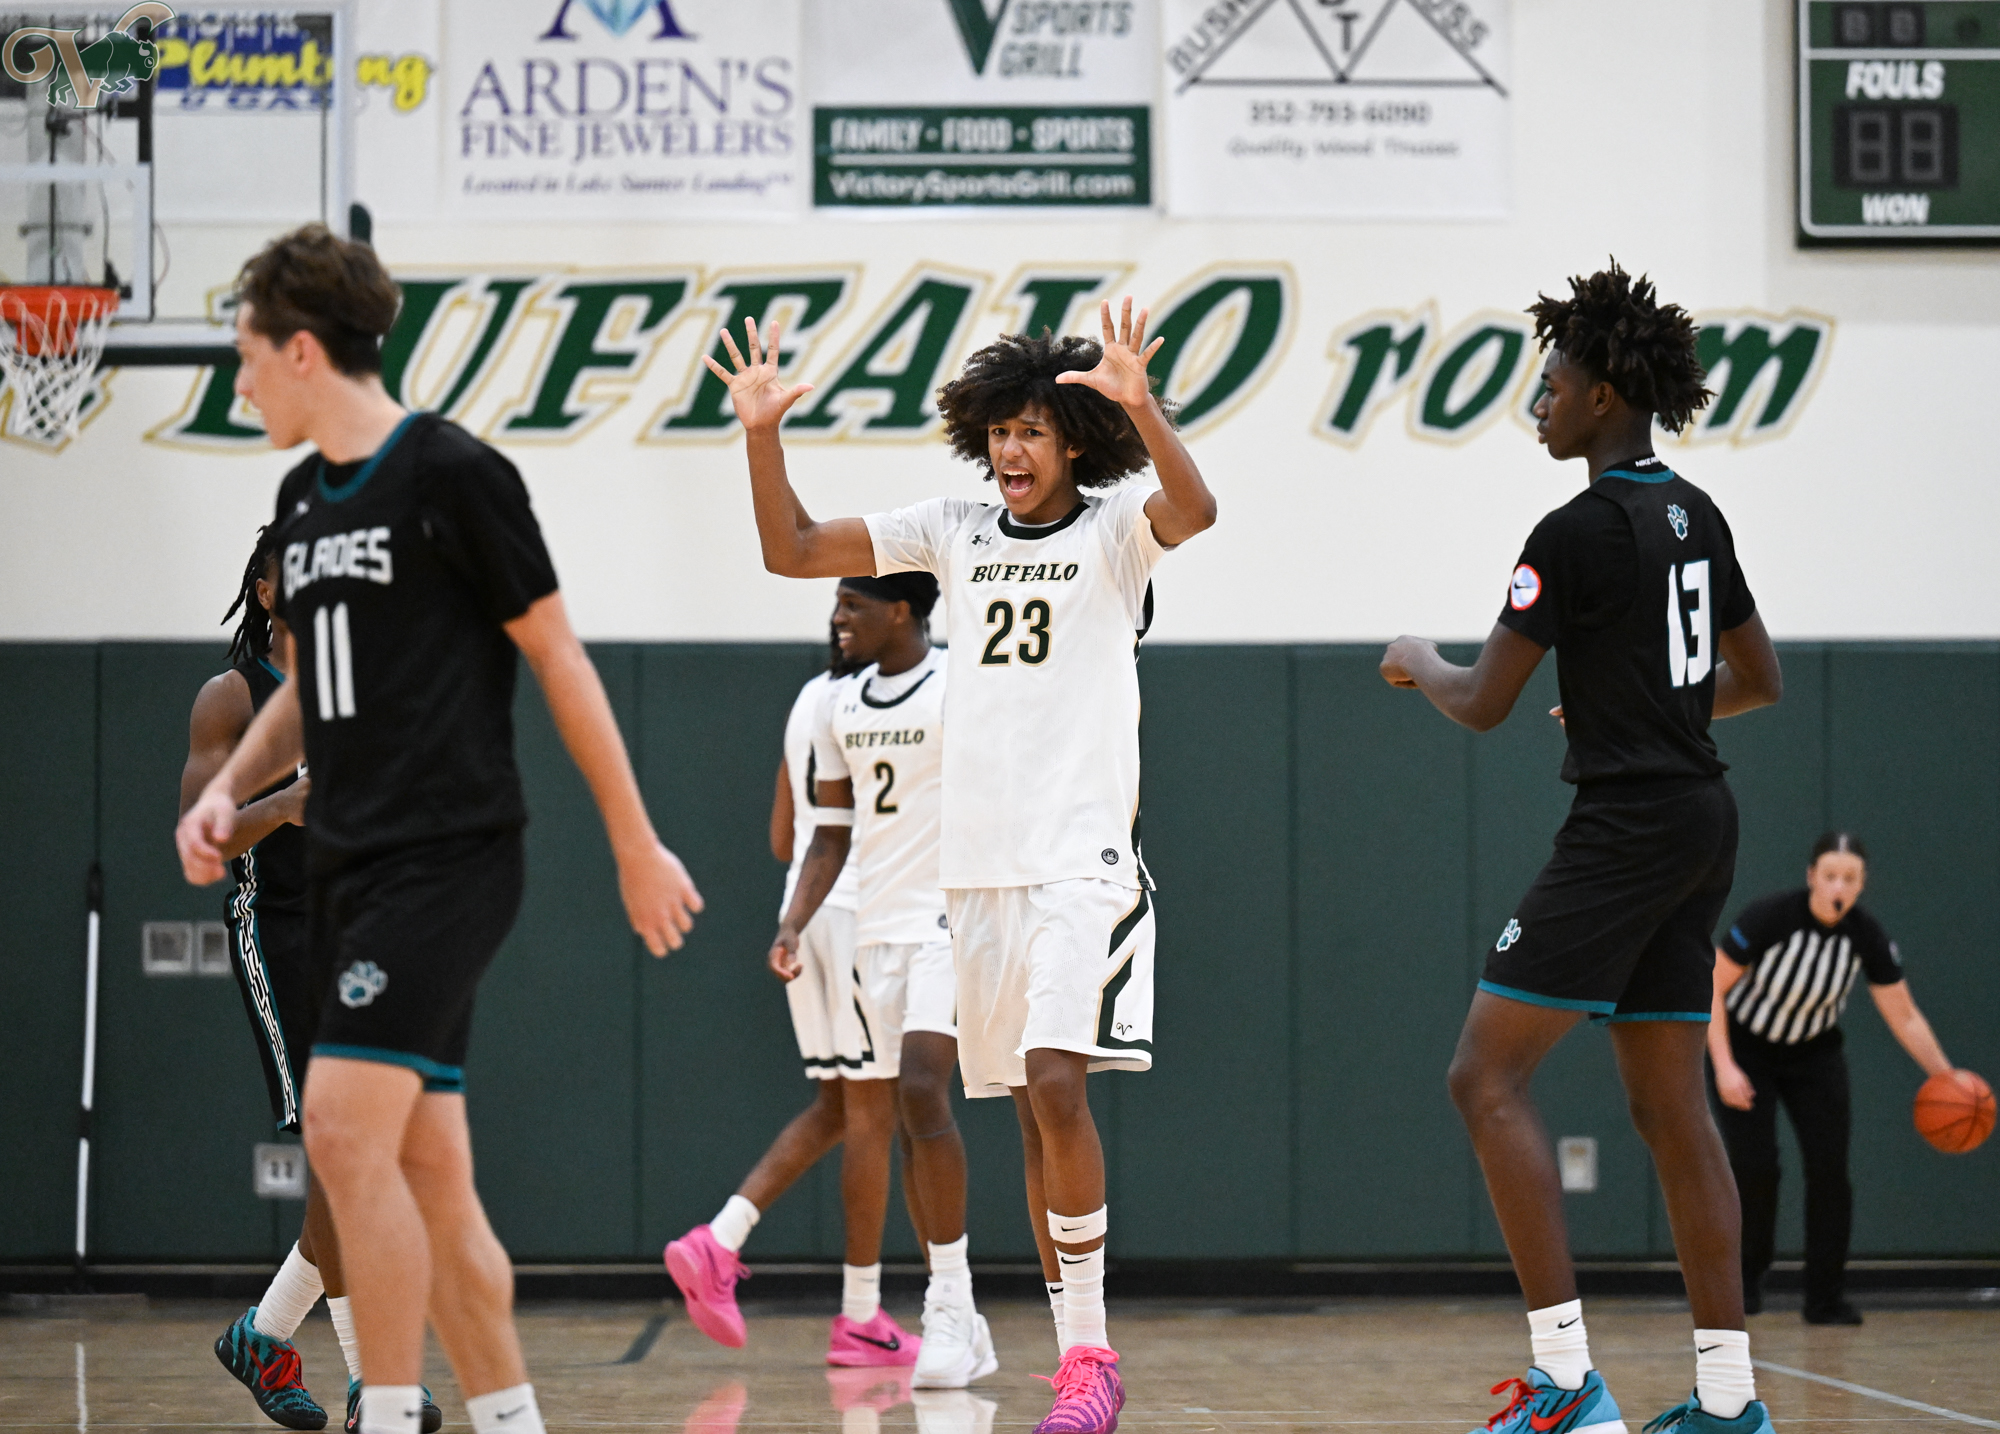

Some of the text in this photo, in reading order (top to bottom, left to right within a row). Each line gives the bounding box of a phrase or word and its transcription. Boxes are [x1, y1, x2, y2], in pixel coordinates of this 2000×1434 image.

[1011, 1, 1133, 35] SPORTS
[999, 42, 1083, 78] GRILL
[1845, 60, 1945, 100] FOULS
[460, 57, 794, 119] ARDEN'S
[461, 120, 794, 166] FINE JEWELERS
[830, 117, 1134, 150] FAMILY FOOD SPORTS
[1861, 194, 1930, 225] WON
[1312, 300, 1836, 450] rom
[968, 562, 1079, 583] BUFFALO
[978, 597, 1053, 667] 23
[1667, 557, 1712, 689] 13
[313, 602, 357, 722] 11
[845, 727, 926, 750] BUFFALO
[873, 760, 898, 815] 2
